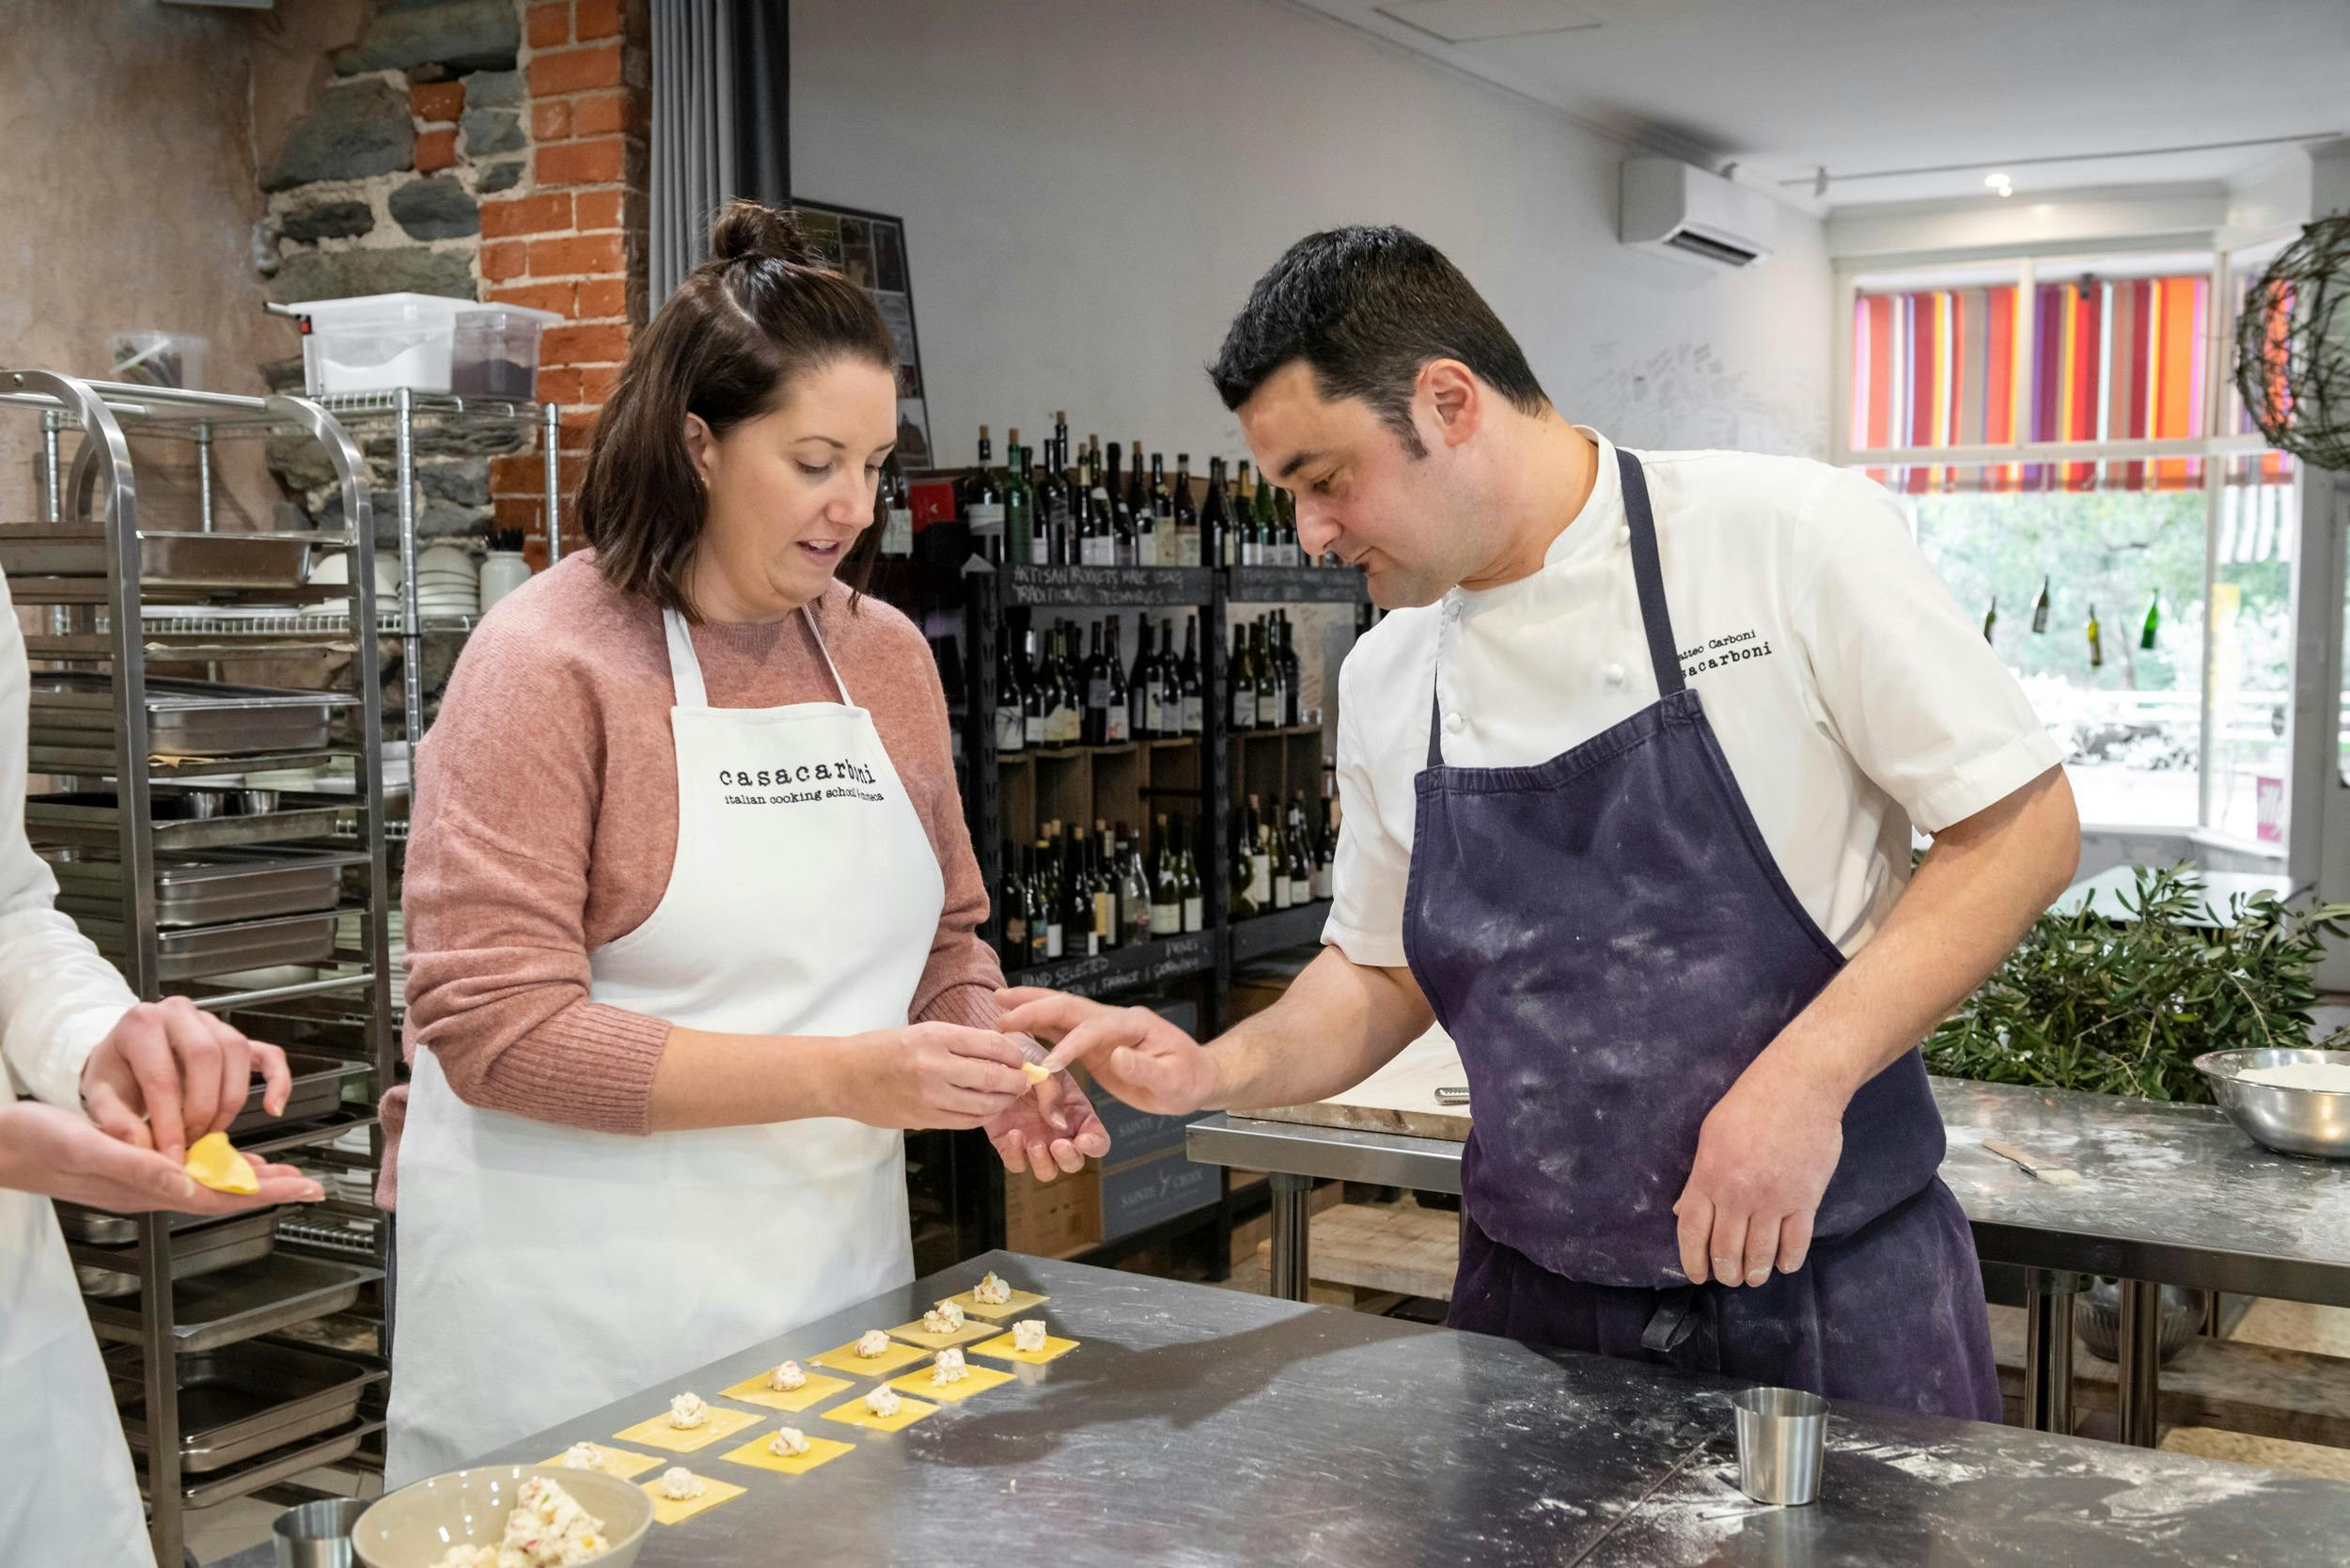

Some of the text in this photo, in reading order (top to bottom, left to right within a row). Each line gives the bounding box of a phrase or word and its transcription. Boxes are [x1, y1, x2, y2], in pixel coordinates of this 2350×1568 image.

[1709, 629, 1757, 650] Carboni
[725, 794, 767, 805] italian
[770, 791, 822, 804] cooking
